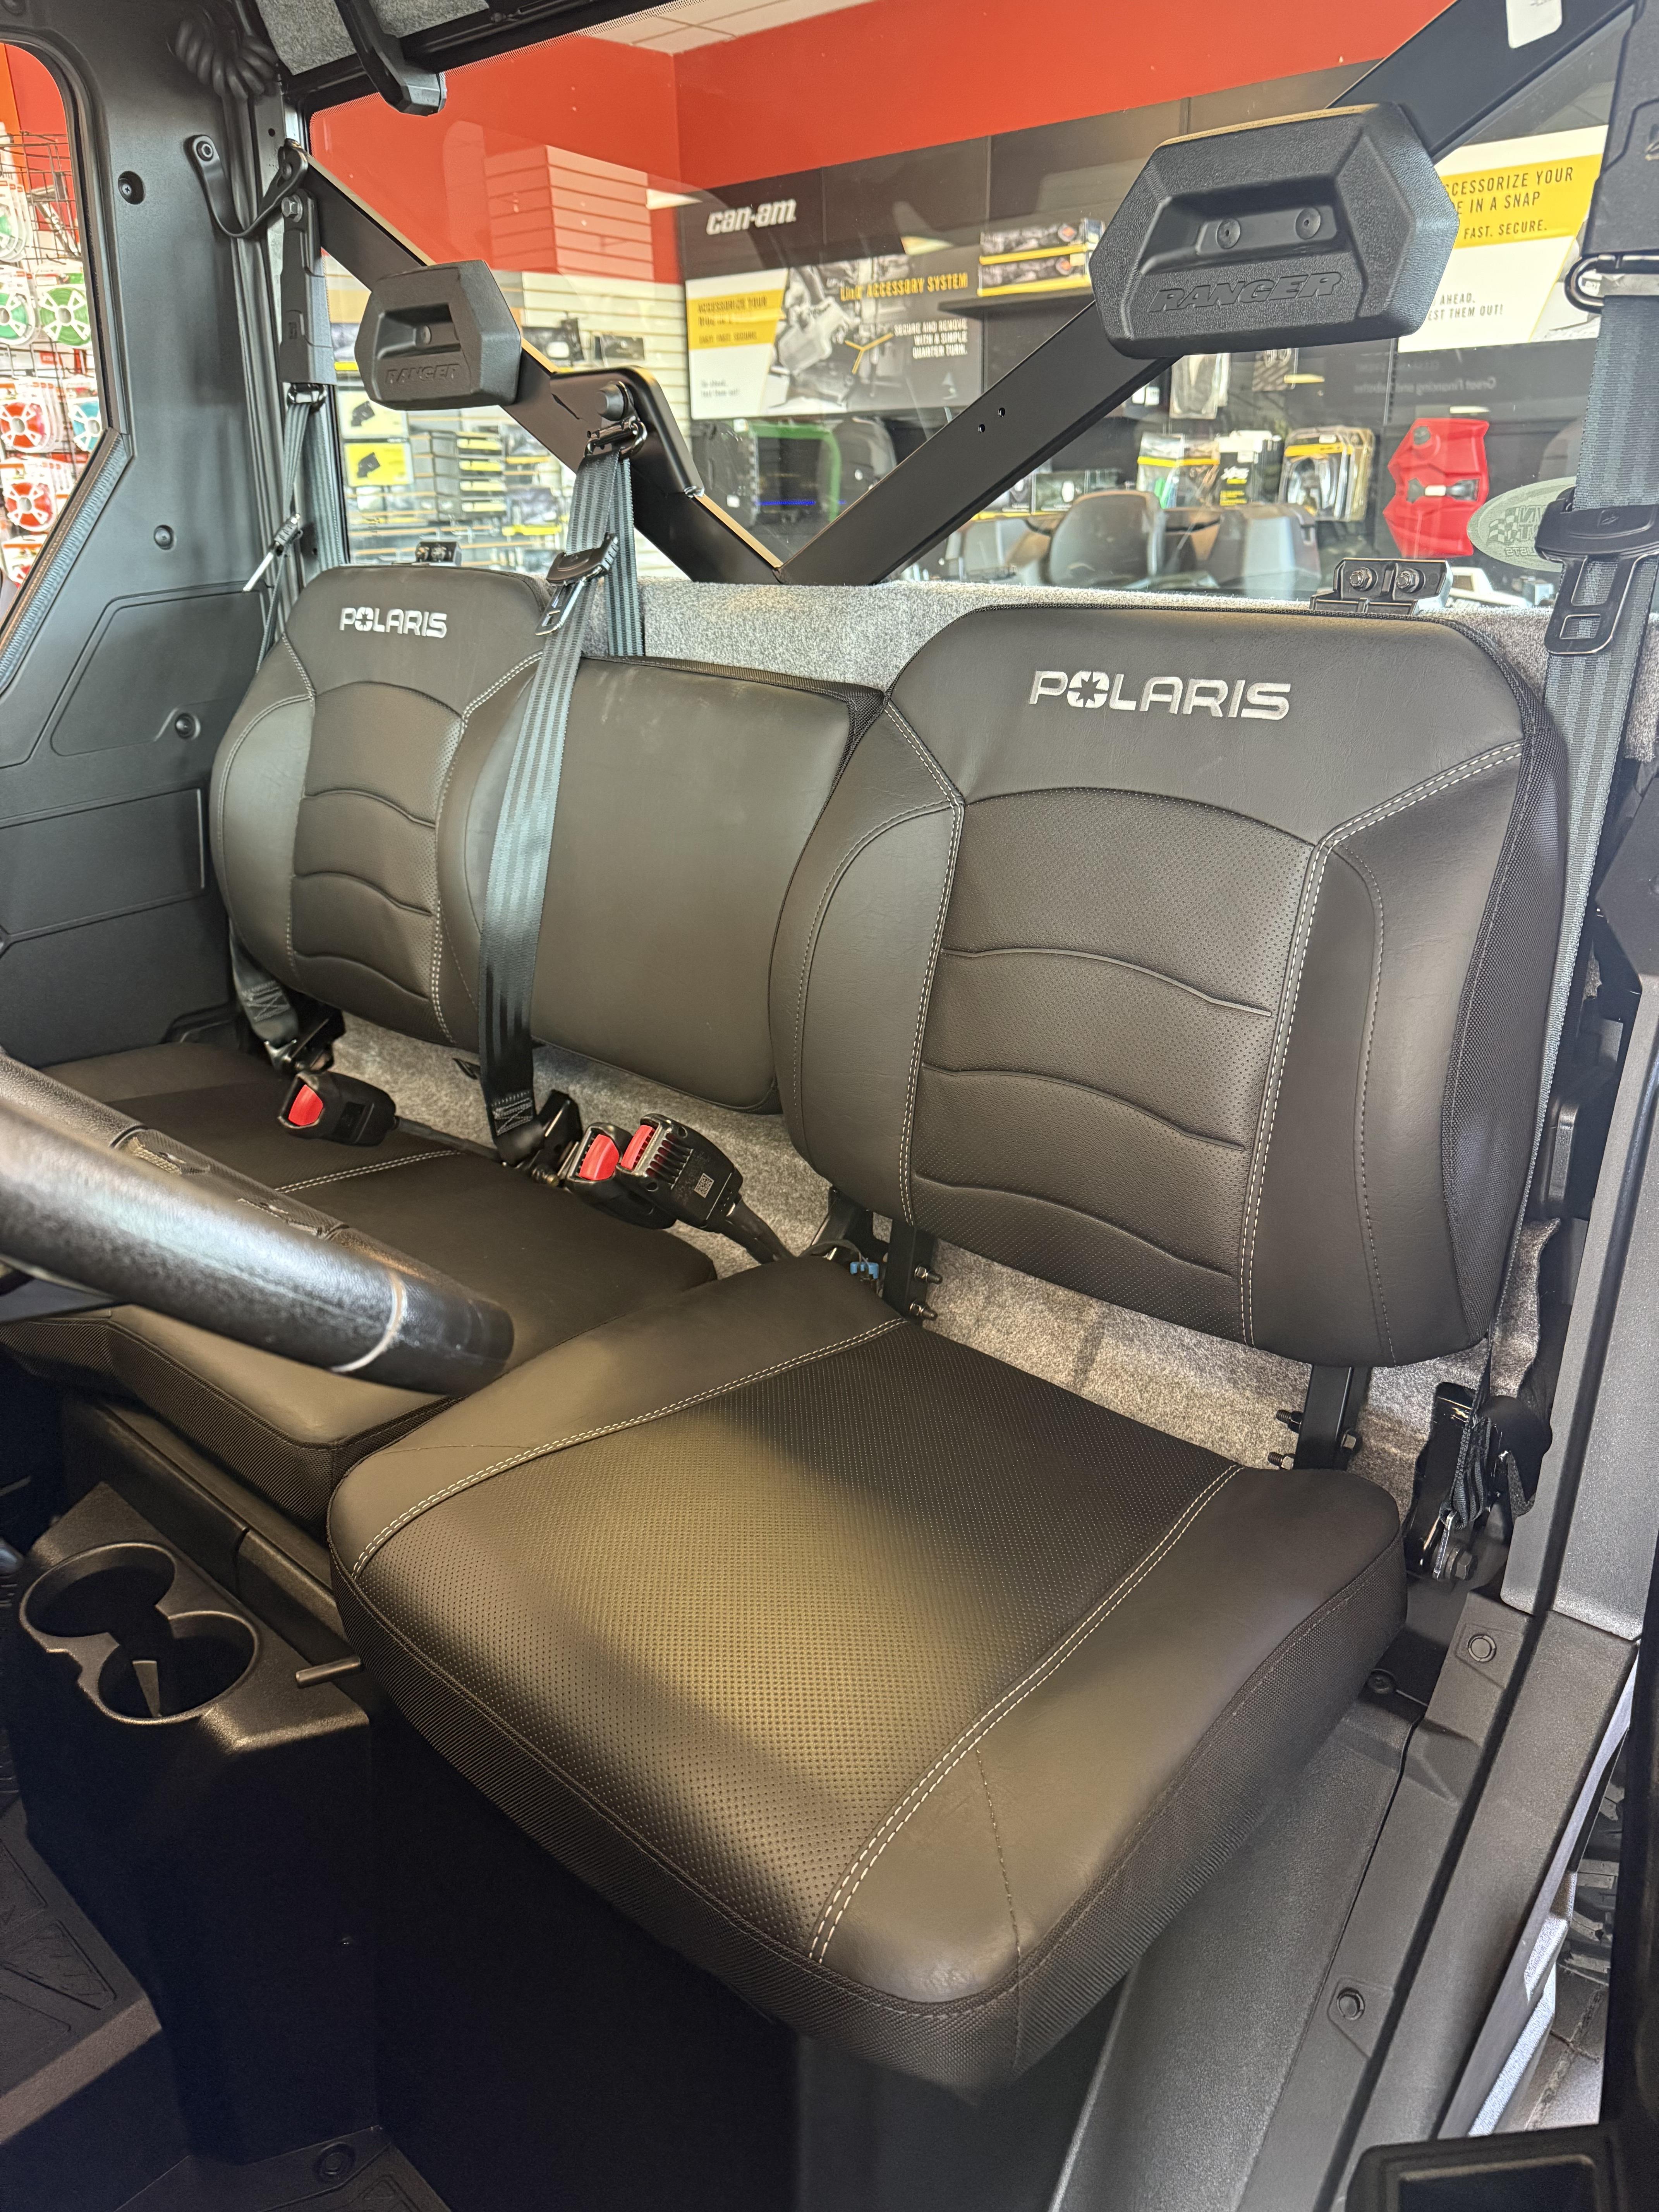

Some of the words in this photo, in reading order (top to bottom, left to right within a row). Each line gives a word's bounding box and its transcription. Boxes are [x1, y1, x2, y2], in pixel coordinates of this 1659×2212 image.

[1445, 173, 1528, 196] CESSORIZE
[1537, 167, 1573, 185] YOUR
[1470, 197, 1484, 213] IN
[1490, 197, 1497, 211] A
[1504, 191, 1540, 209] SNAP
[706, 198, 796, 235] can-am
[1464, 226, 1493, 240] FAST.
[1499, 219, 1547, 235] SECURE.
[867, 278, 924, 297] ACCESSORY
[927, 273, 968, 292] SYSTEM
[1147, 272, 1341, 313] RANGER
[1428, 308, 1444, 321] EST
[1449, 307, 1474, 319] THEM
[1480, 304, 1503, 316] OUT!
[914, 333, 933, 346] WITH
[934, 333, 940, 344] A
[941, 331, 967, 344] SIMPLE
[922, 321, 937, 333] AND
[385, 363, 461, 383] RANGER
[339, 606, 447, 638] POLARIS
[1029, 670, 1291, 720] POLARIS
